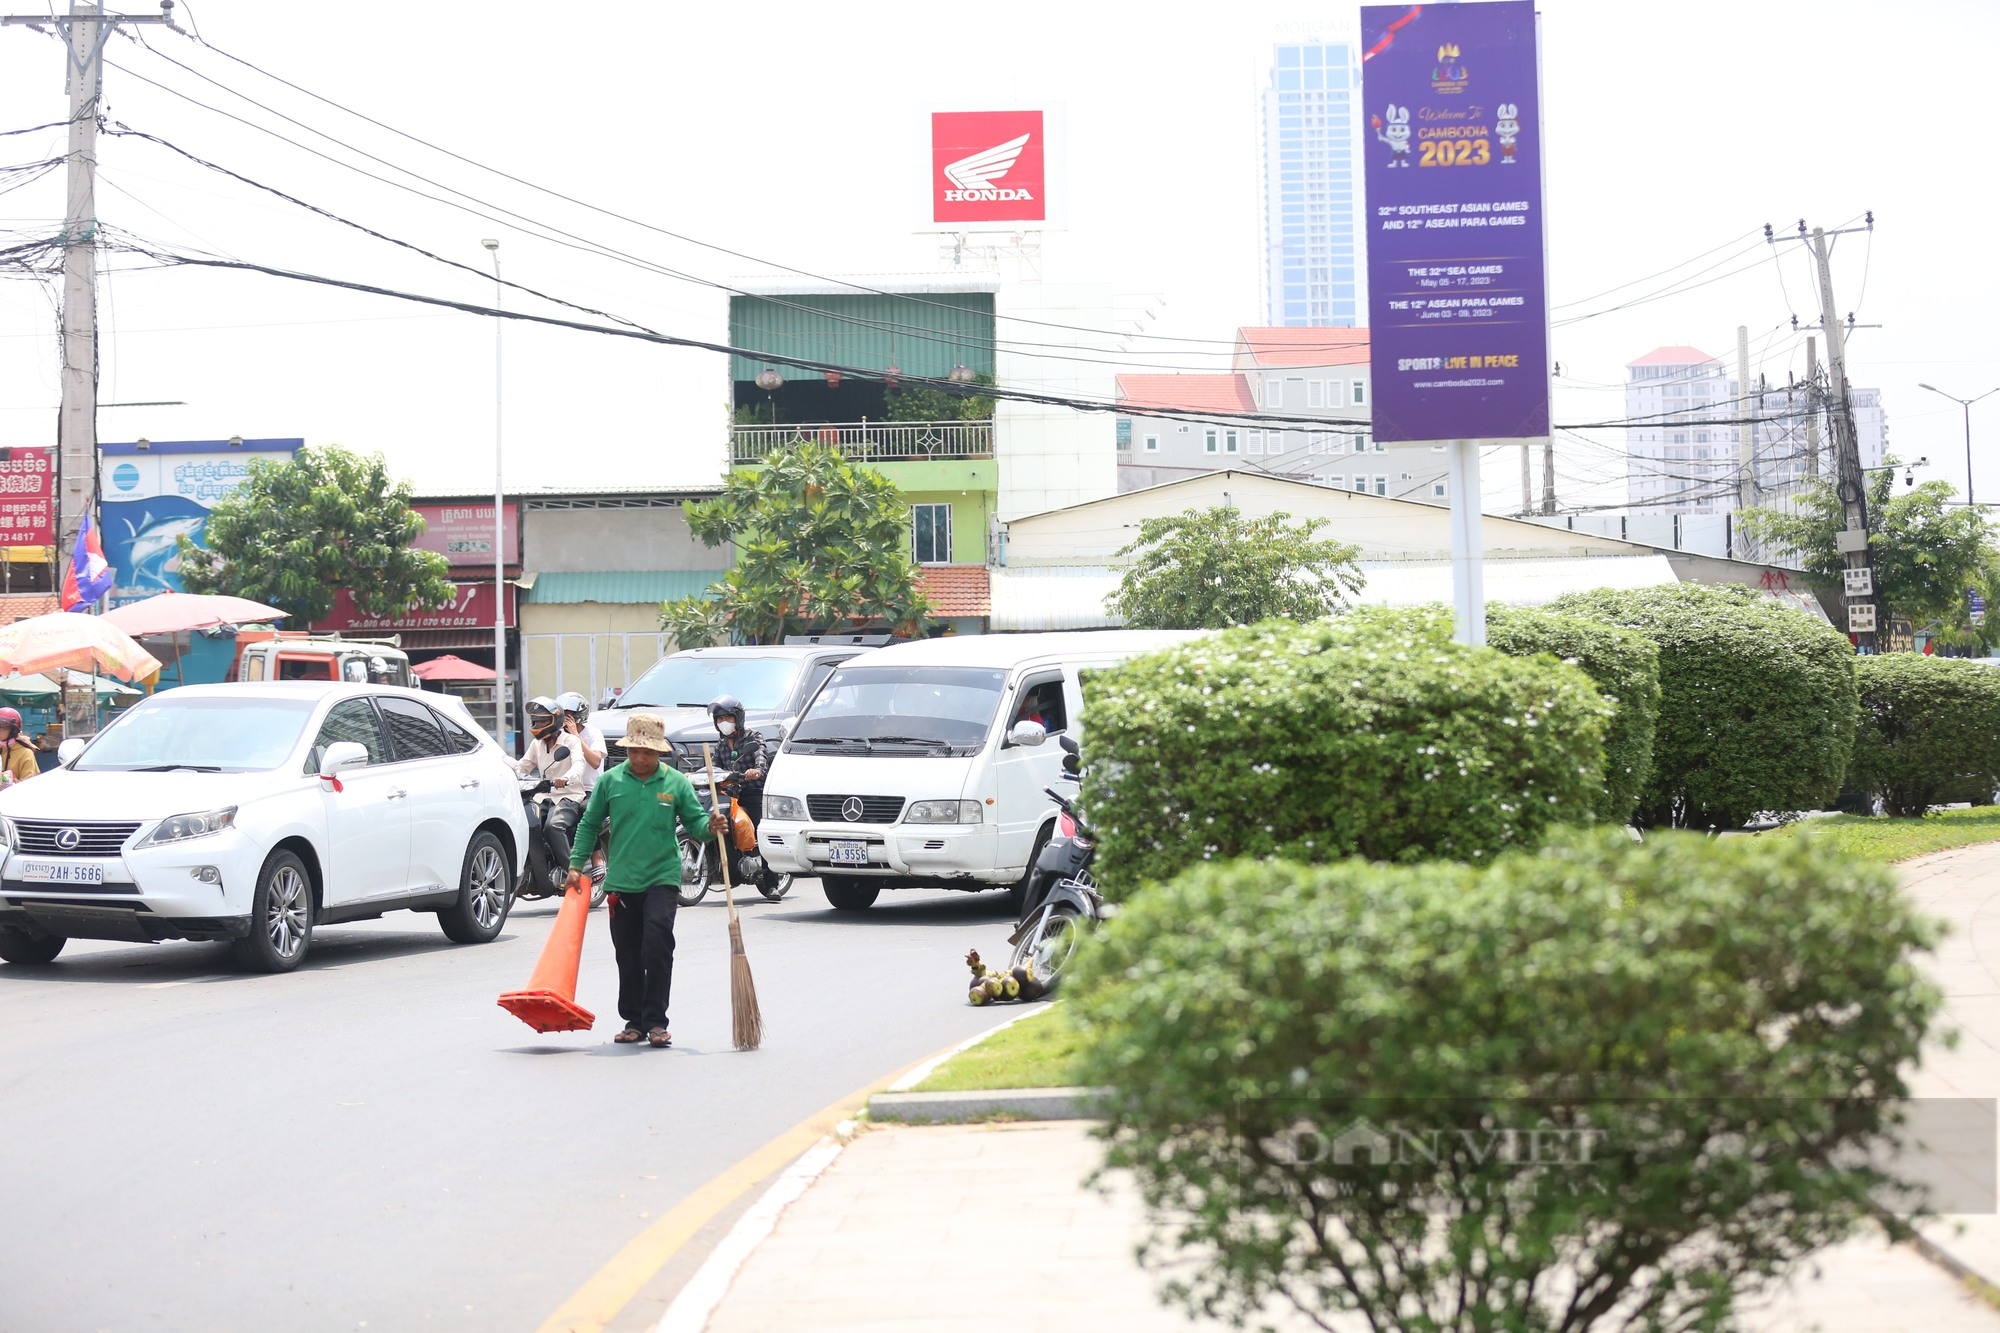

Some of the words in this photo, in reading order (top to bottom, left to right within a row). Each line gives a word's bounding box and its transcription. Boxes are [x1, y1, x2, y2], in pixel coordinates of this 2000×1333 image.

[1275, 20, 1350, 33] MORGAN
[1418, 106, 1466, 121] Welcome
[1468, 105, 1485, 120] To
[1418, 125, 1489, 139] CAMBODIA
[1418, 138, 1491, 167] 2023
[943, 188, 1034, 202] HONDA
[1398, 204, 1459, 215] SOUTHEAST
[1460, 203, 1491, 213] ASIAN
[1492, 201, 1529, 212] GAMES
[1382, 220, 1405, 230] AND
[1424, 218, 1459, 229] ASEAN
[1460, 217, 1488, 227] PARA
[1488, 215, 1526, 226] GAMES
[1408, 268, 1428, 276] THE
[1446, 266, 1467, 275] SEA
[1467, 265, 1503, 275] GAMES
[1420, 279, 1437, 288] May
[1470, 277, 1490, 285] 2023
[1389, 301, 1409, 310] THE
[1427, 299, 1460, 308] ASEAN
[1461, 298, 1488, 307] PARA
[1488, 297, 1524, 306] GAMES
[1420, 310, 1440, 319] June
[1397, 357, 1441, 371] SPORTS
[1444, 356, 1467, 369] LIVE
[1469, 356, 1482, 368] IN
[1484, 355, 1519, 368] PEACE
[1413, 378, 1504, 388] www.cambodia2023.com
[11, 532, 35, 541] 4817
[422, 617, 438, 626] 070
